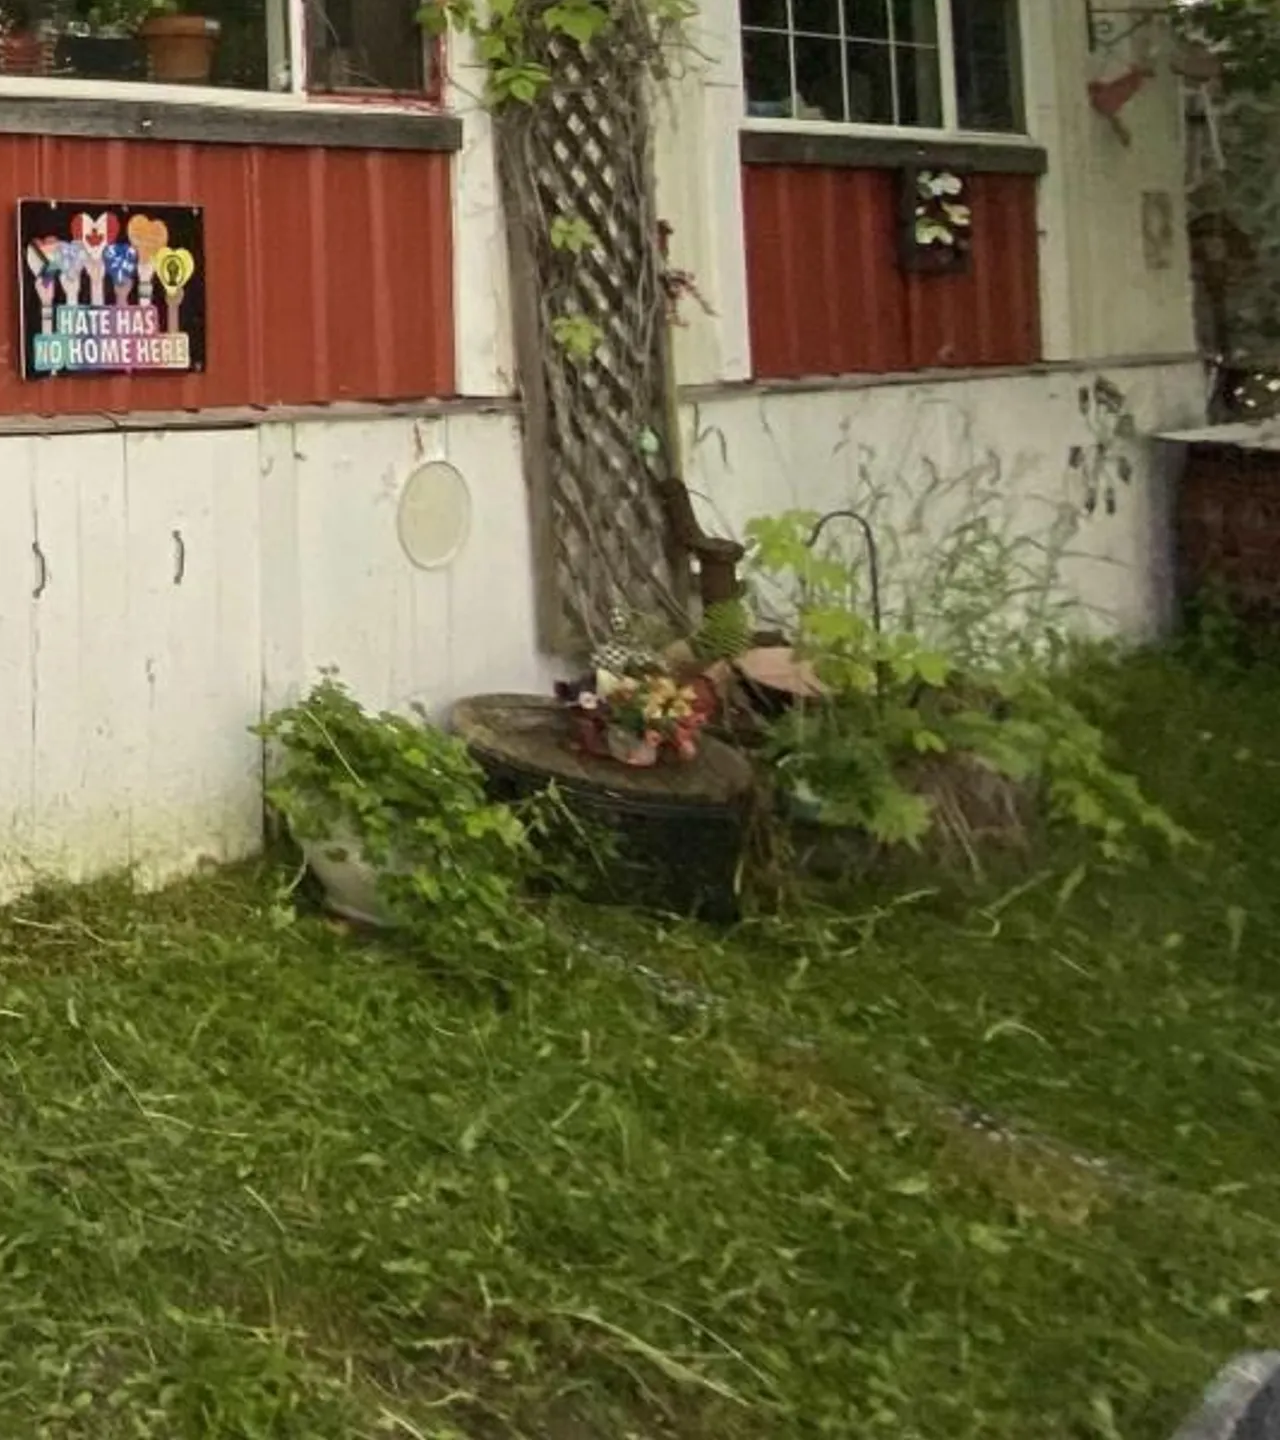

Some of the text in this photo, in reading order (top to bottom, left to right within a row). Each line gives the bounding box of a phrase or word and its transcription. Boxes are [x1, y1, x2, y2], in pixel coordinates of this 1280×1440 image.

[59, 309, 156, 336] HATE HAS
[36, 335, 186, 364] NO HOME HERE
